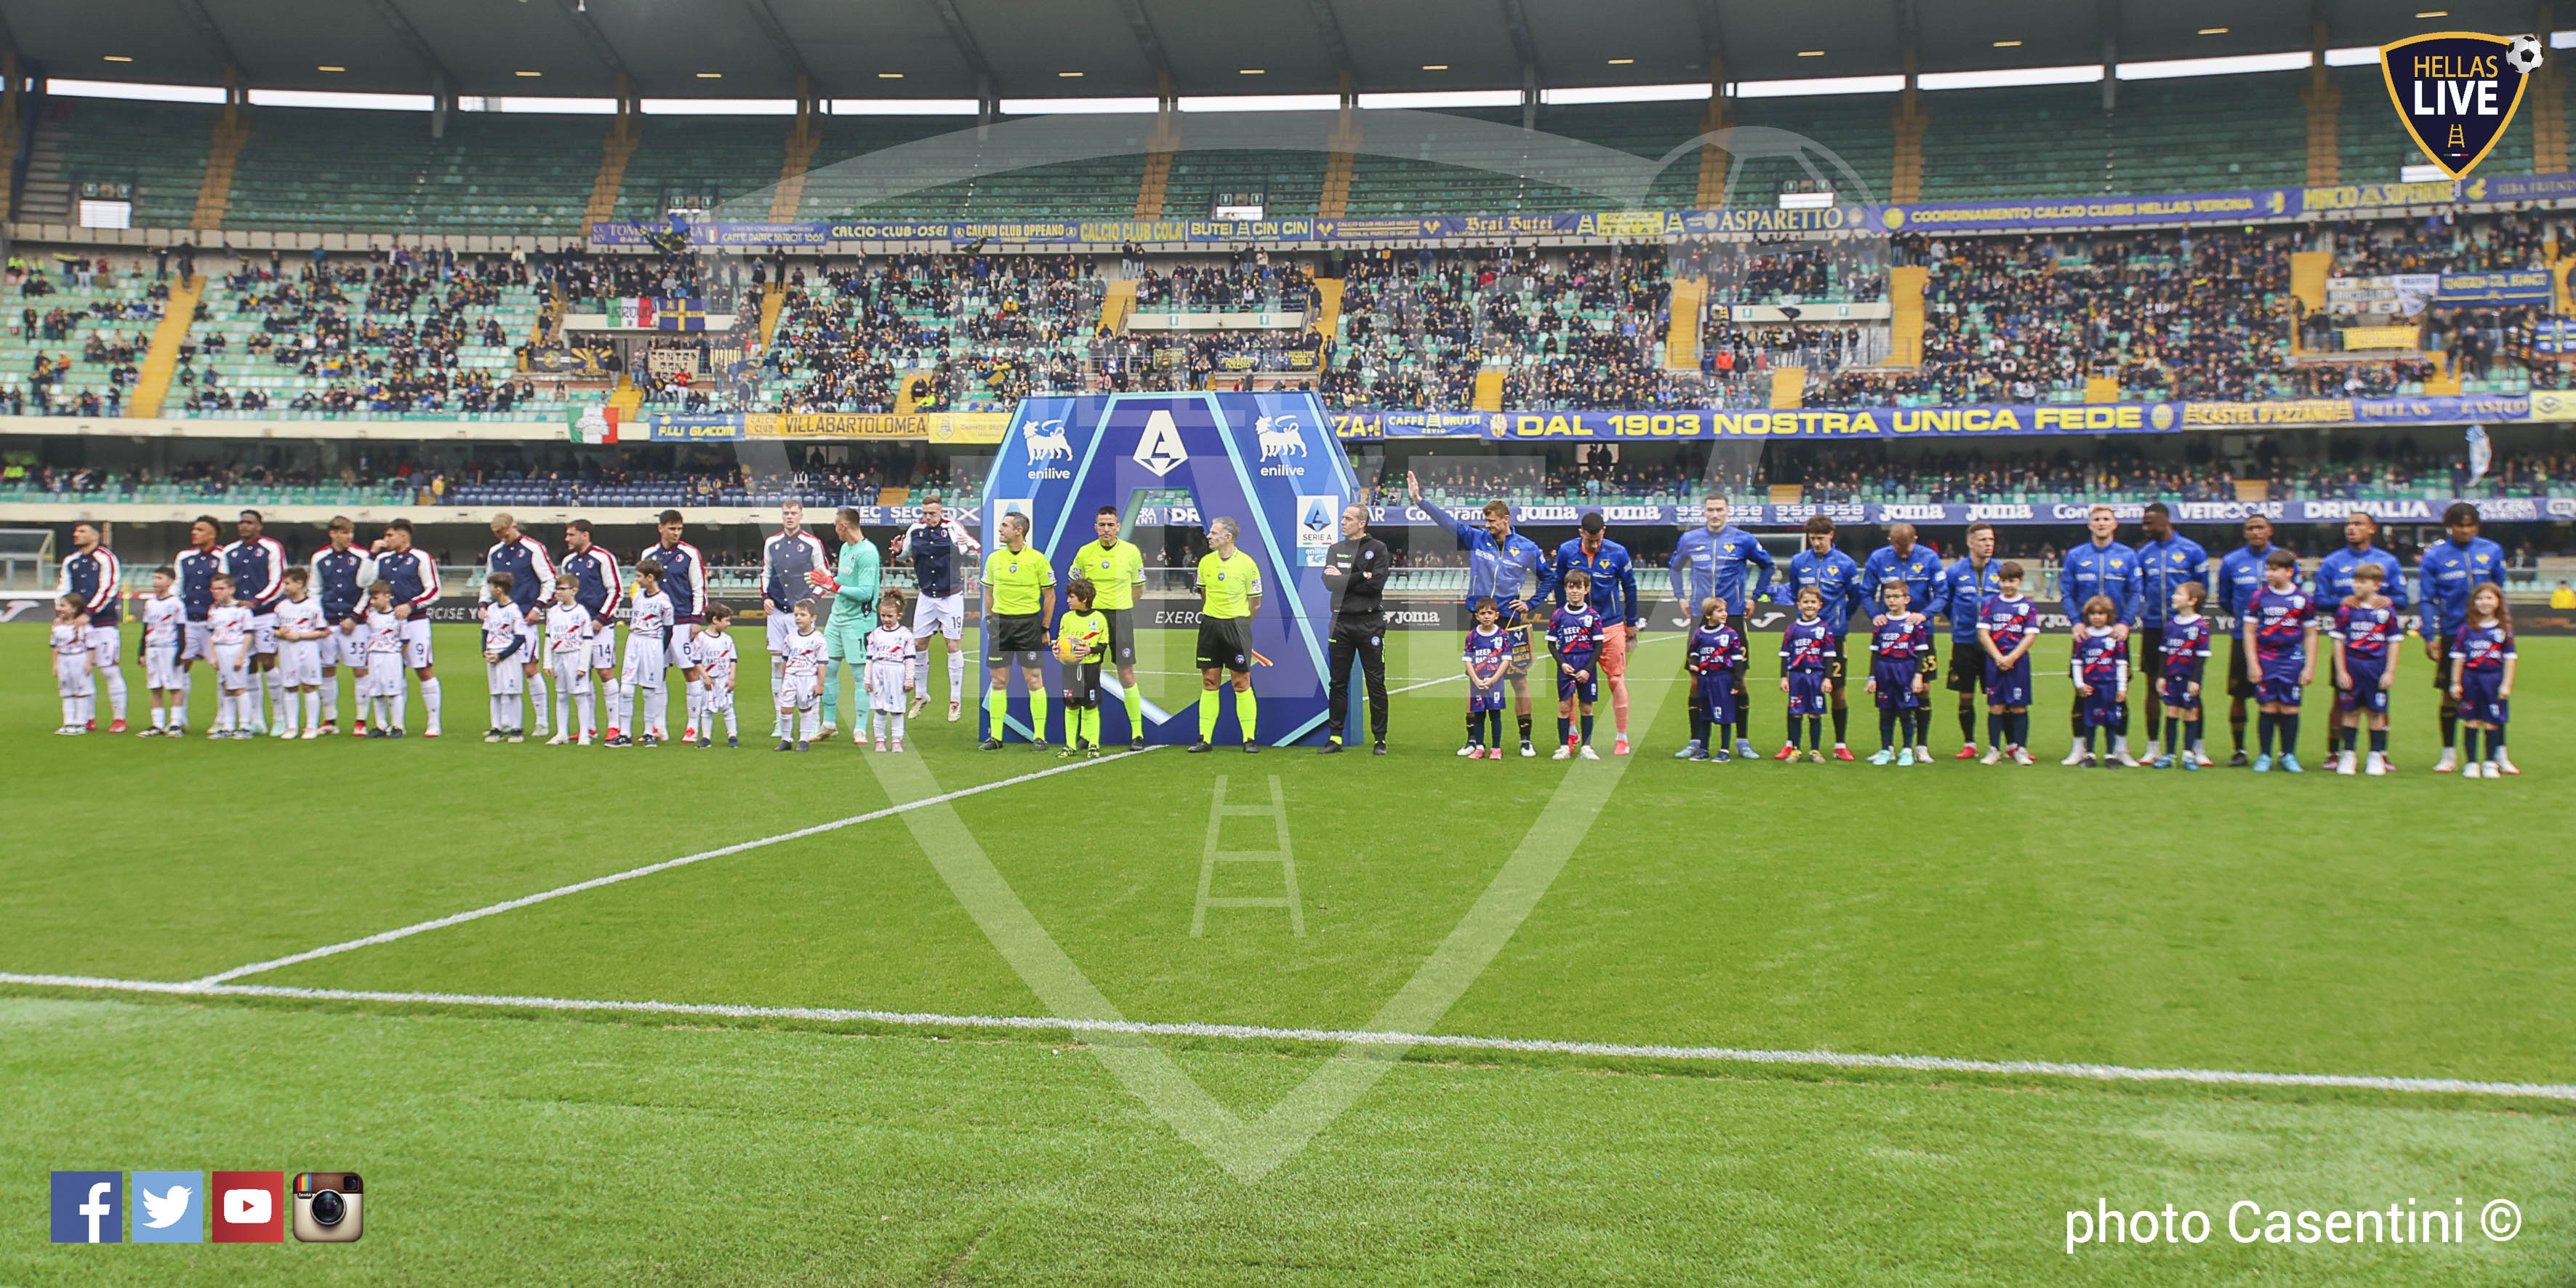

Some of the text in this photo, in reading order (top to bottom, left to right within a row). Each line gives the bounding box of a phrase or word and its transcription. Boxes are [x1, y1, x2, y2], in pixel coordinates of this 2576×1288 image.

[1911, 207, 2032, 223] COORDINAMENTO
[2034, 204, 2087, 218] CALCIO
[2137, 200, 2193, 215] HELLAS
[2193, 198, 2254, 212] VERONA
[1720, 207, 1843, 231] ASPARETTO
[966, 224, 1064, 236] CALCIO CLUB OPPEANO
[1080, 223, 1120, 241] CALCIO
[1123, 223, 1152, 240] CLUB
[1191, 221, 1308, 236] BUTEI CIN CIN
[785, 413, 926, 433] VILLABARTOLOMEA
[1330, 415, 1367, 437] ZA
[1443, 415, 1480, 425] BRUTTI
[1517, 406, 2142, 436] DAL 1903 NOSTRA UNICA FEDE
[755, 425, 773, 433] CLUB
[1027, 469, 1071, 480] enilive
[1260, 466, 1304, 477] enilive
[951, 617, 962, 629] 19
[1155, 611, 1203, 624] EXERC
[1395, 611, 1440, 624] Joma
[1564, 627, 1581, 635] KEEP
[349, 642, 364, 655] 33
[416, 643, 425, 655] 9
[598, 644, 611, 655] 14
[683, 642, 691, 655] 6
[1832, 663, 1842, 677] 2
